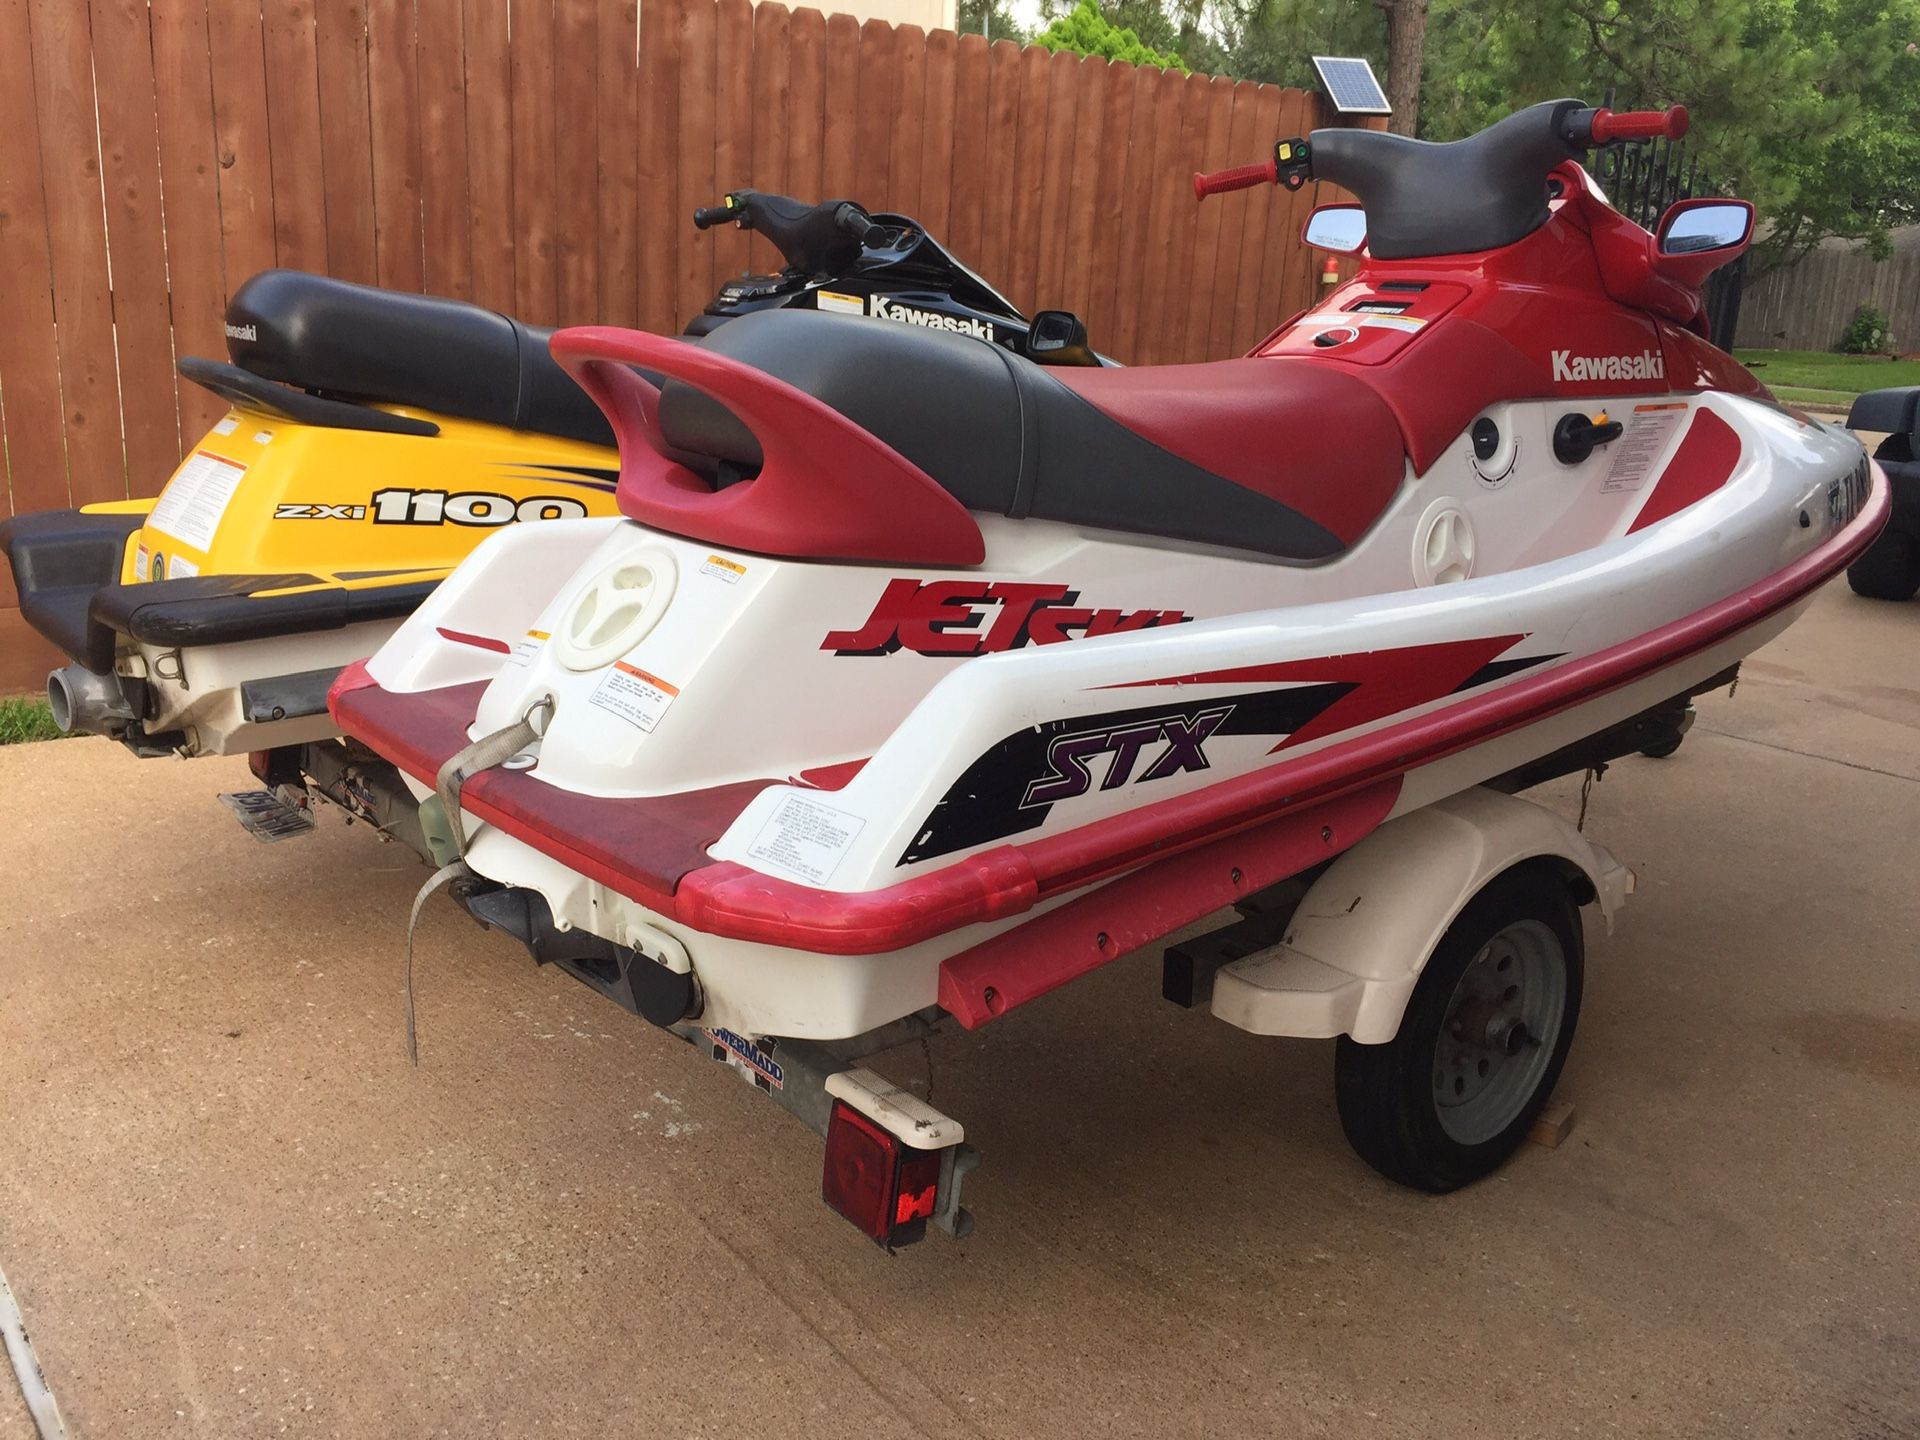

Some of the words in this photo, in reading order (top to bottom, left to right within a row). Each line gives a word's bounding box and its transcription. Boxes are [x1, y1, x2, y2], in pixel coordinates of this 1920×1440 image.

[224, 320, 257, 341] awasaki
[870, 294, 994, 342] Kawasaki
[1551, 349, 1664, 382] Kawasaki
[371, 487, 588, 527] 1100
[819, 578, 1081, 656] JET
[1019, 705, 1236, 810] STX
